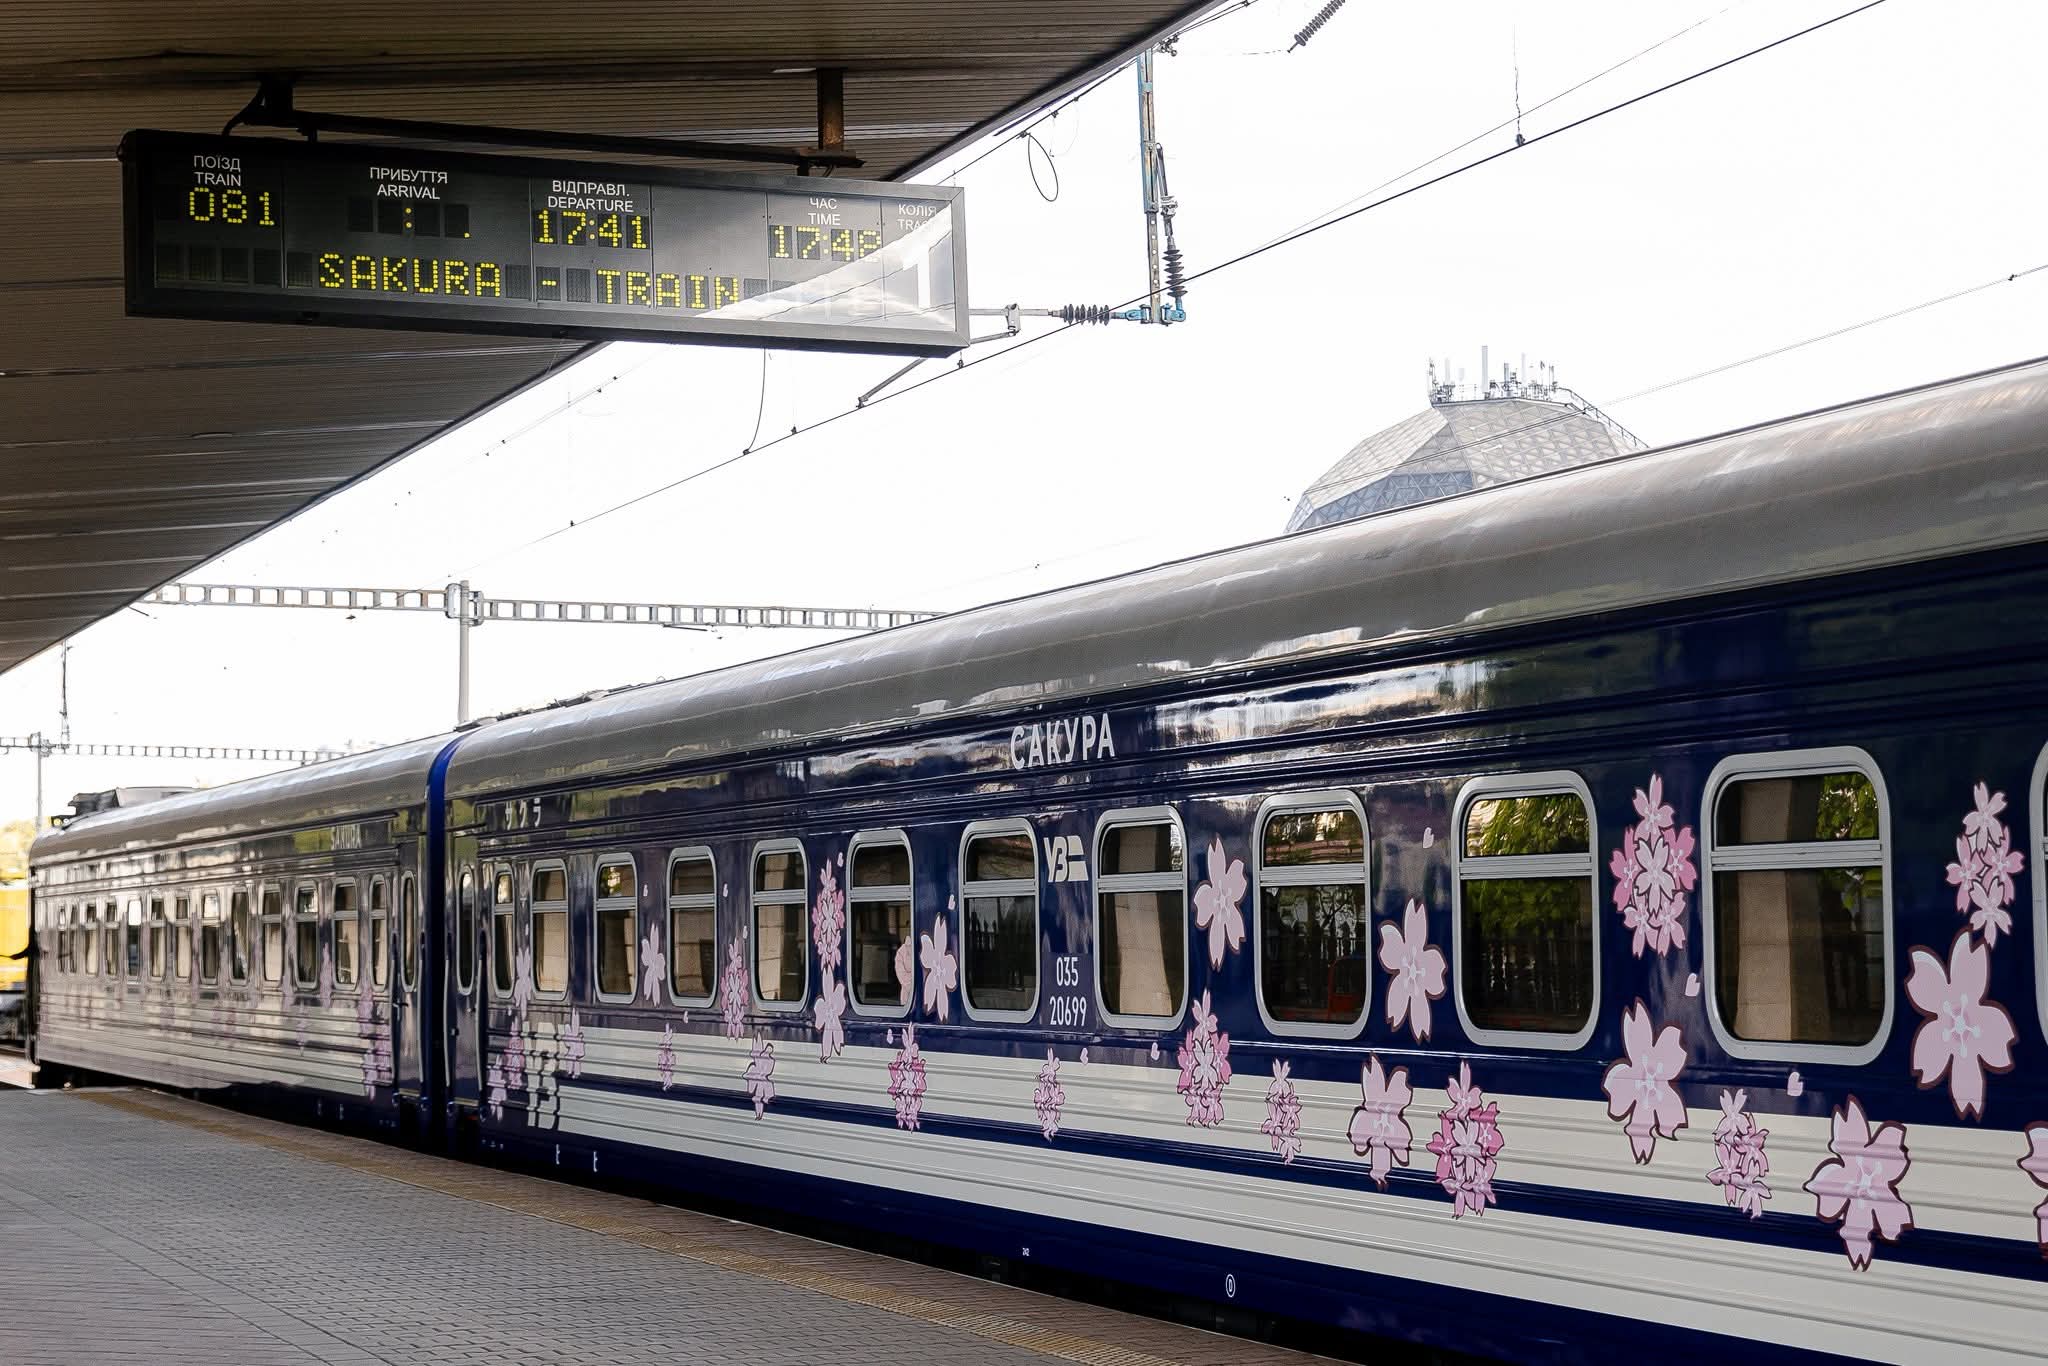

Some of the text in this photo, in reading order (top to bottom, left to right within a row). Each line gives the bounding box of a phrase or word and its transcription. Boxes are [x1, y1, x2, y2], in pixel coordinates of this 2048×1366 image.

[193, 154, 241, 173] ПОЇЗД
[193, 171, 241, 187] TRAIN
[370, 166, 448, 184] ПРИБУТТЯ
[376, 183, 441, 200] ARRIVAL
[552, 179, 631, 198] ВІДПРАВЛ.
[189, 187, 275, 226] 081
[547, 195, 634, 213] DEPARTURE
[809, 197, 838, 211] ЧАС
[898, 203, 938, 217] КОЛІЯ
[808, 211, 842, 227] TIME
[896, 217, 935, 232] TRA
[537, 209, 647, 249] 17:41
[319, 252, 501, 298] SAKURA
[596, 268, 740, 310] TRAIN
[1010, 712, 1116, 770] САКУРА
[504, 796, 542, 831] サクラ
[1056, 956, 1079, 987] 035
[1049, 995, 1087, 1027] 20699
